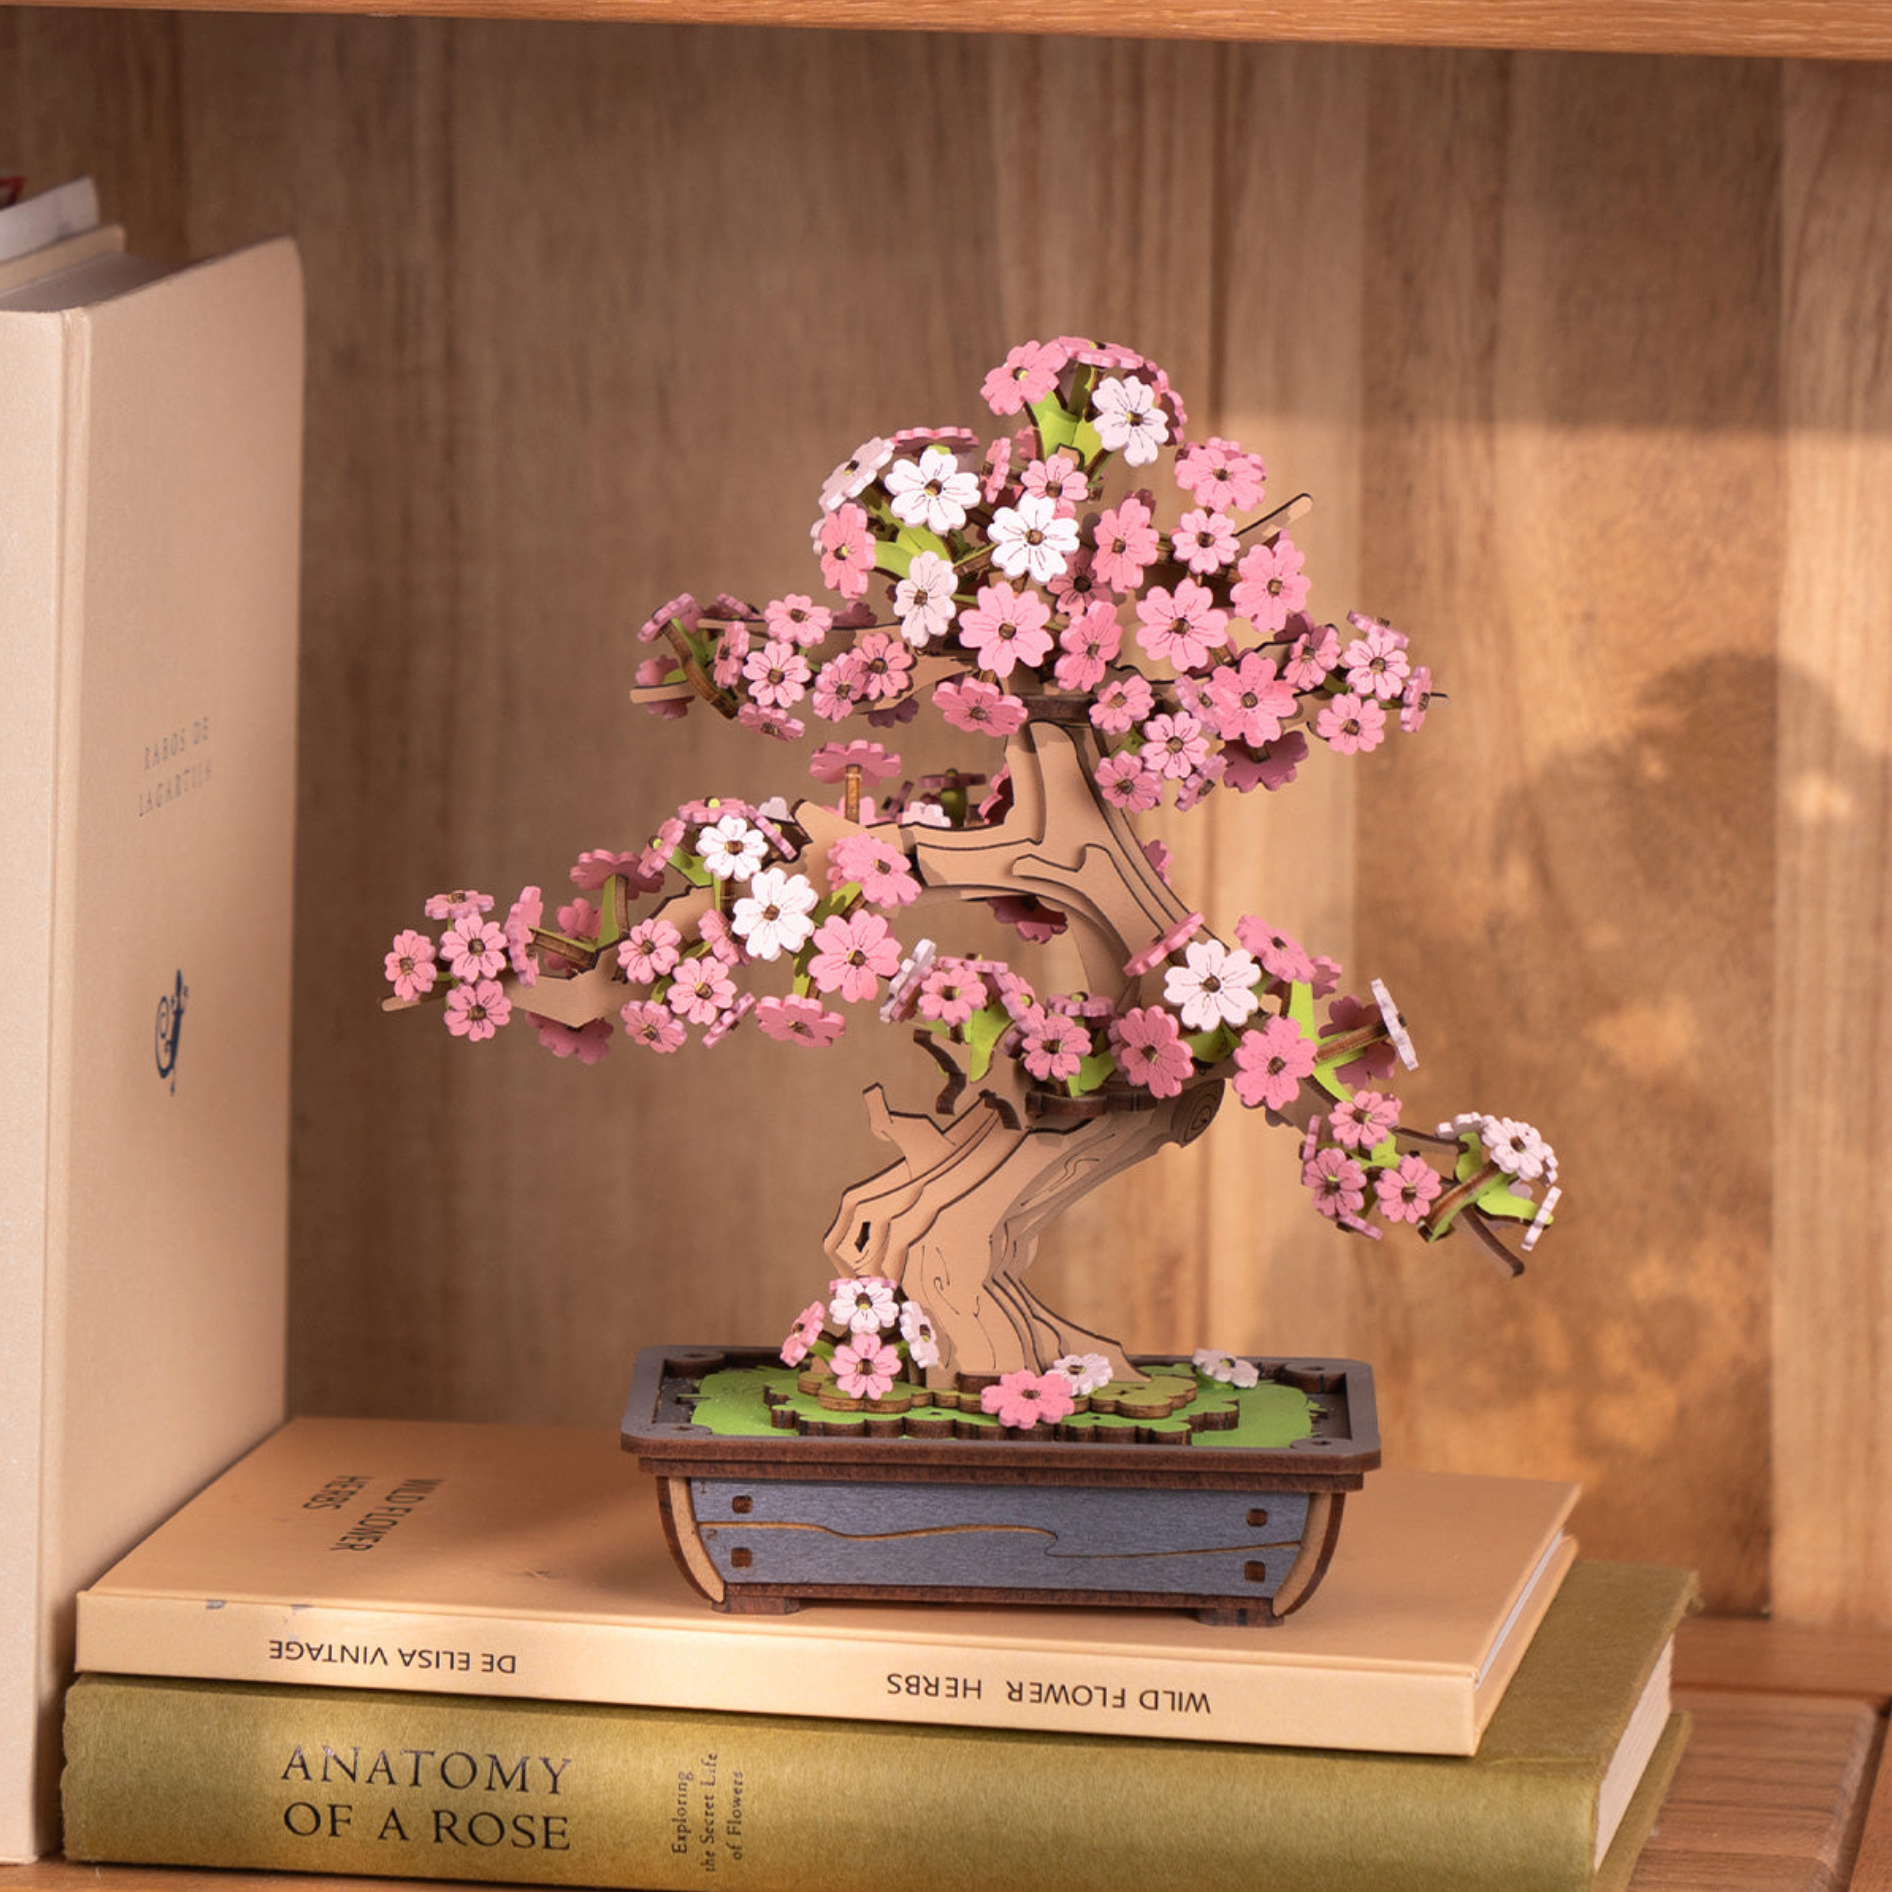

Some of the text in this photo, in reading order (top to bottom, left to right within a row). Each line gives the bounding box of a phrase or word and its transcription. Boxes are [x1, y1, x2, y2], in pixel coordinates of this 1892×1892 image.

[303, 1475, 373, 1510] HERBS
[330, 1479, 444, 1551] WILD FLOWER
[707, 1529, 718, 1540] 2
[268, 1640, 517, 1674] DE ELISA VINTAGE
[886, 1673, 1212, 1714] WILD FLOWER HERBS
[281, 1744, 573, 1796] ANATOMY
[283, 1801, 571, 1851] OF A ROSE
[672, 1771, 694, 1855] Exploring
[700, 1753, 717, 1872] the Secret Life
[726, 1771, 743, 1861] of Flowers
